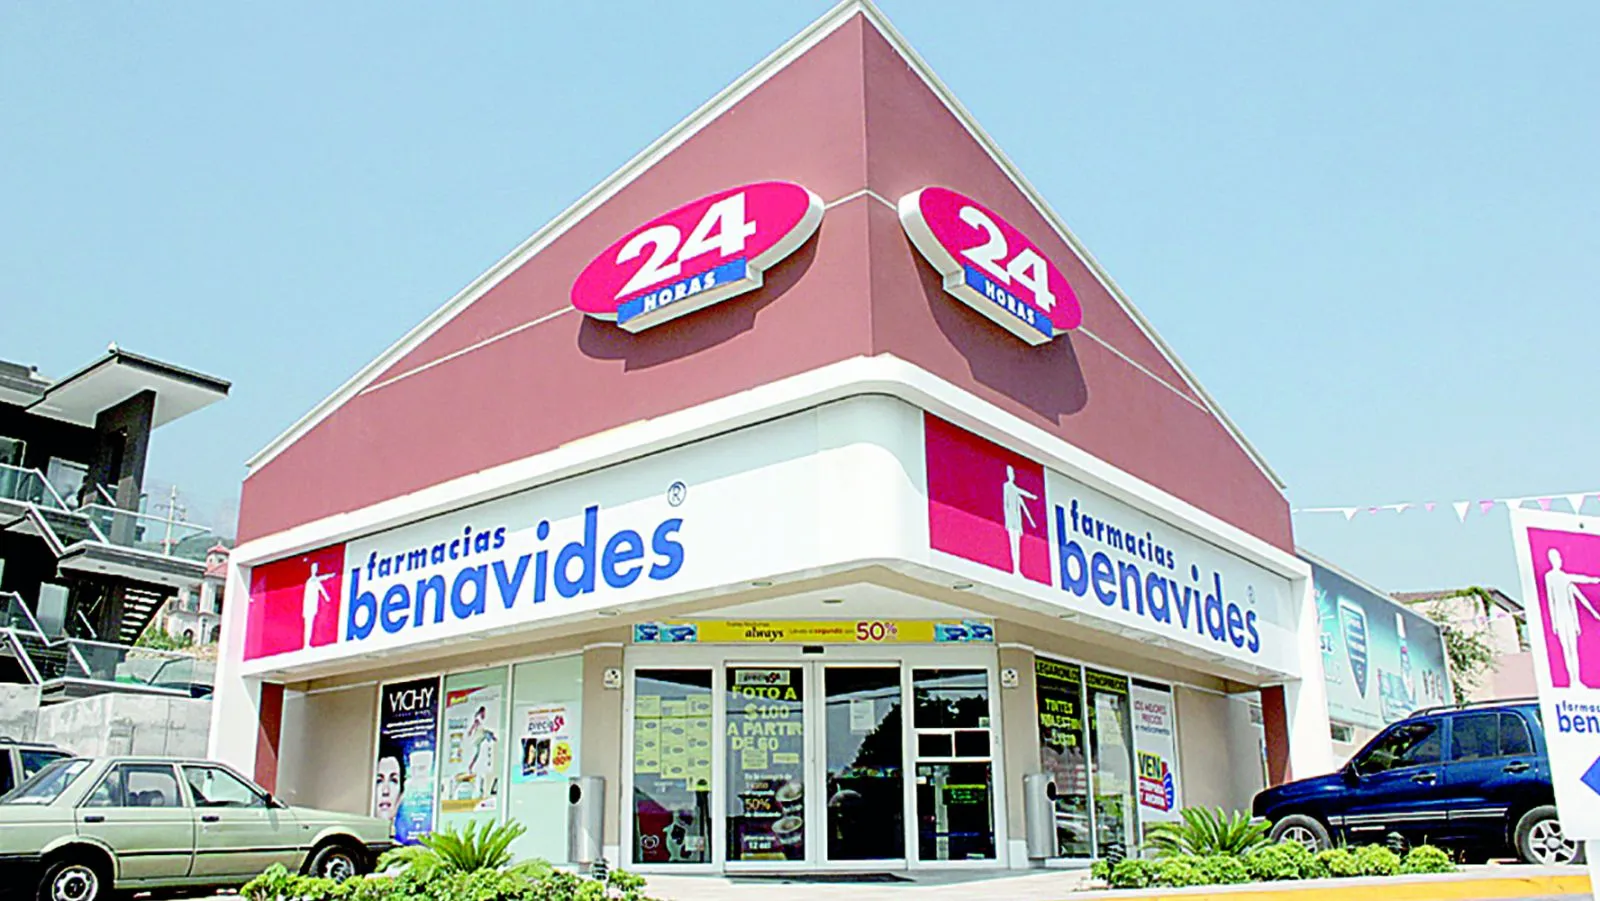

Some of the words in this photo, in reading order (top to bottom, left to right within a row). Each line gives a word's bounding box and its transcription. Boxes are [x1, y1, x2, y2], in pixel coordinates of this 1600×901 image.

[614, 192, 756, 300] 24
[959, 205, 1056, 313] 24
[643, 271, 716, 313] HORAS
[985, 279, 1035, 325] HORAS
[367, 526, 506, 581] farmacias
[1070, 500, 1175, 570] farmacias
[346, 505, 684, 641] benavides
[1055, 504, 1260, 654] benavides
[745, 626, 784, 642] always
[856, 622, 898, 641] 50%
[389, 687, 434, 712] VICHY
[732, 686, 781, 700] FOTO
[784, 687, 797, 700] A
[727, 722, 739, 736] A
[1137, 752, 1161, 778] VEN
[745, 798, 771, 810] 50%
